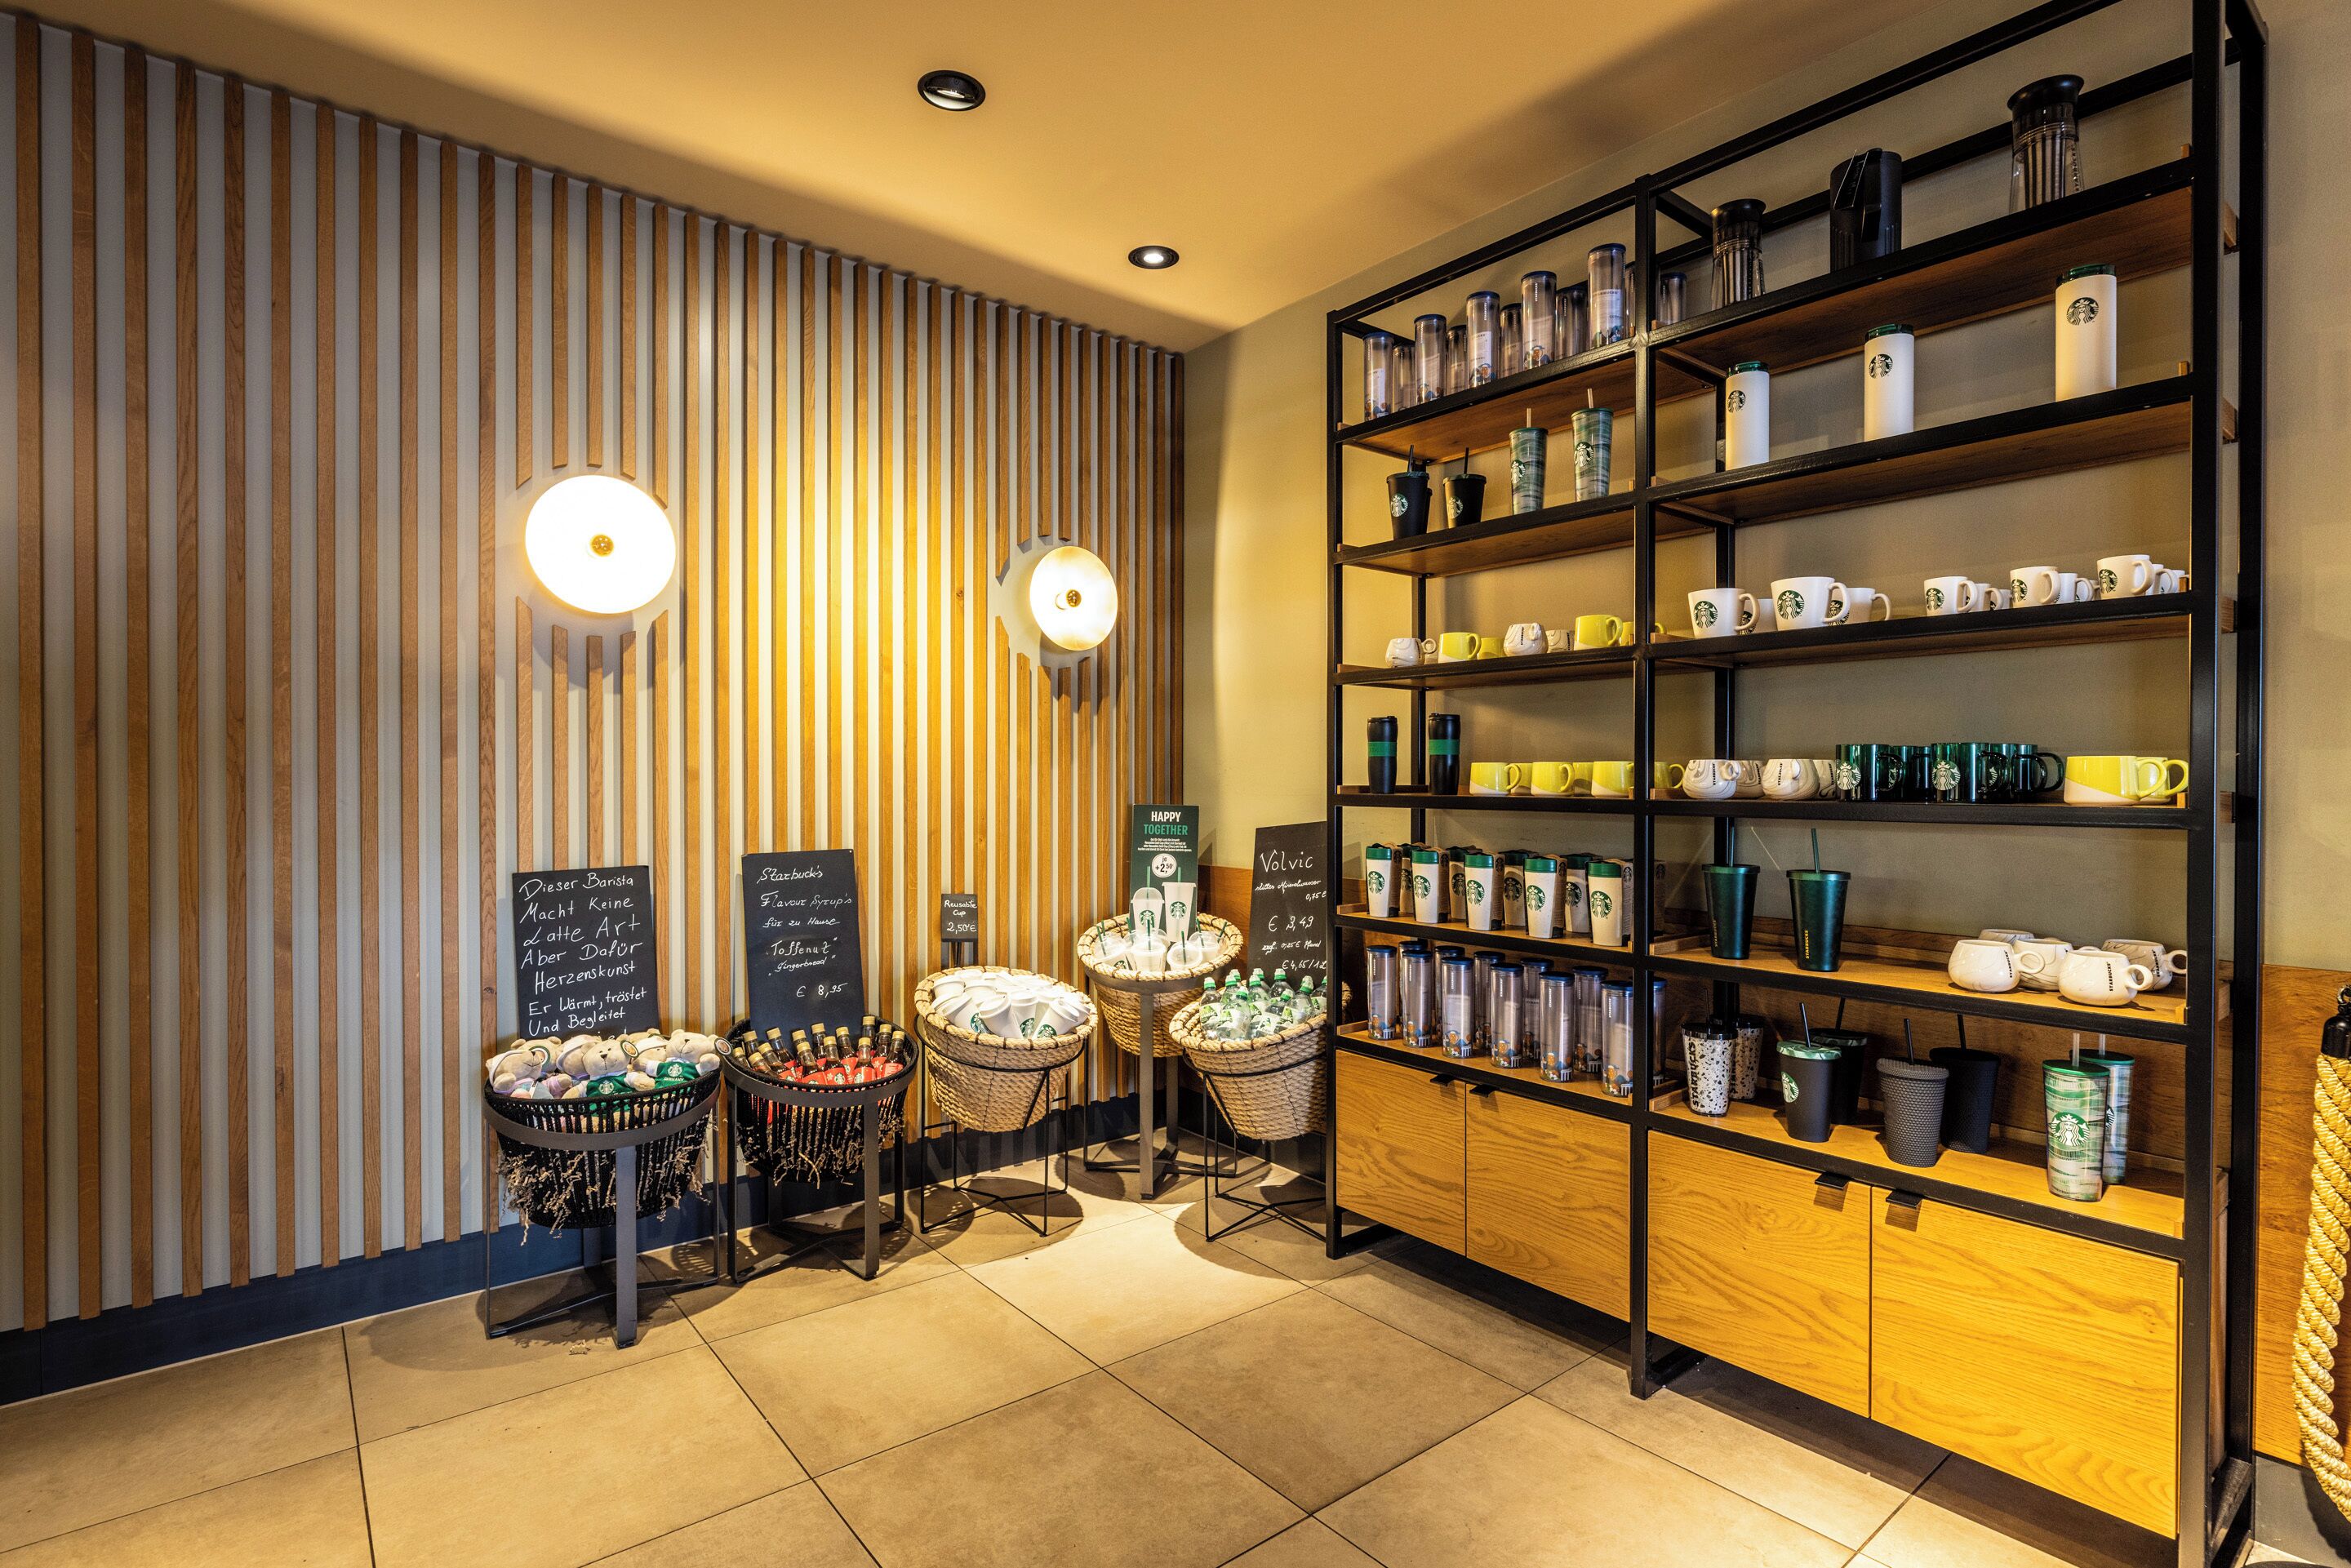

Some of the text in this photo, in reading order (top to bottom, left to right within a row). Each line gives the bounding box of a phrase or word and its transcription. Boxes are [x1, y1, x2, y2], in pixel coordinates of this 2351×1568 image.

[1144, 824, 1189, 835] TOGETHER
[1151, 811, 1181, 822] HAPPY
[1260, 849, 1313, 873] Volvic
[518, 872, 633, 901] Dieser Barista
[1305, 892, 1322, 902] 0,75
[519, 896, 634, 924] Macht Keine
[760, 891, 852, 910] Flavour Syrup's
[953, 909, 967, 917] Cup
[523, 913, 641, 947] Latte Art
[762, 917, 784, 928] für
[807, 917, 841, 926] Hause
[1268, 915, 1314, 932] € 3,49
[520, 939, 643, 970] Aber Dafür
[1304, 939, 1322, 950] Pfand
[2004, 950, 2013, 978] STARBUCKS
[2152, 949, 2161, 978] STARBUCKS
[535, 960, 637, 996] Herzenskunst
[796, 982, 849, 999] € 8,95
[528, 986, 647, 1016] Er Wärmt, tröstet
[528, 1006, 626, 1037] Und Begleitet
[1688, 1041, 1699, 1108] STARBUCKS
